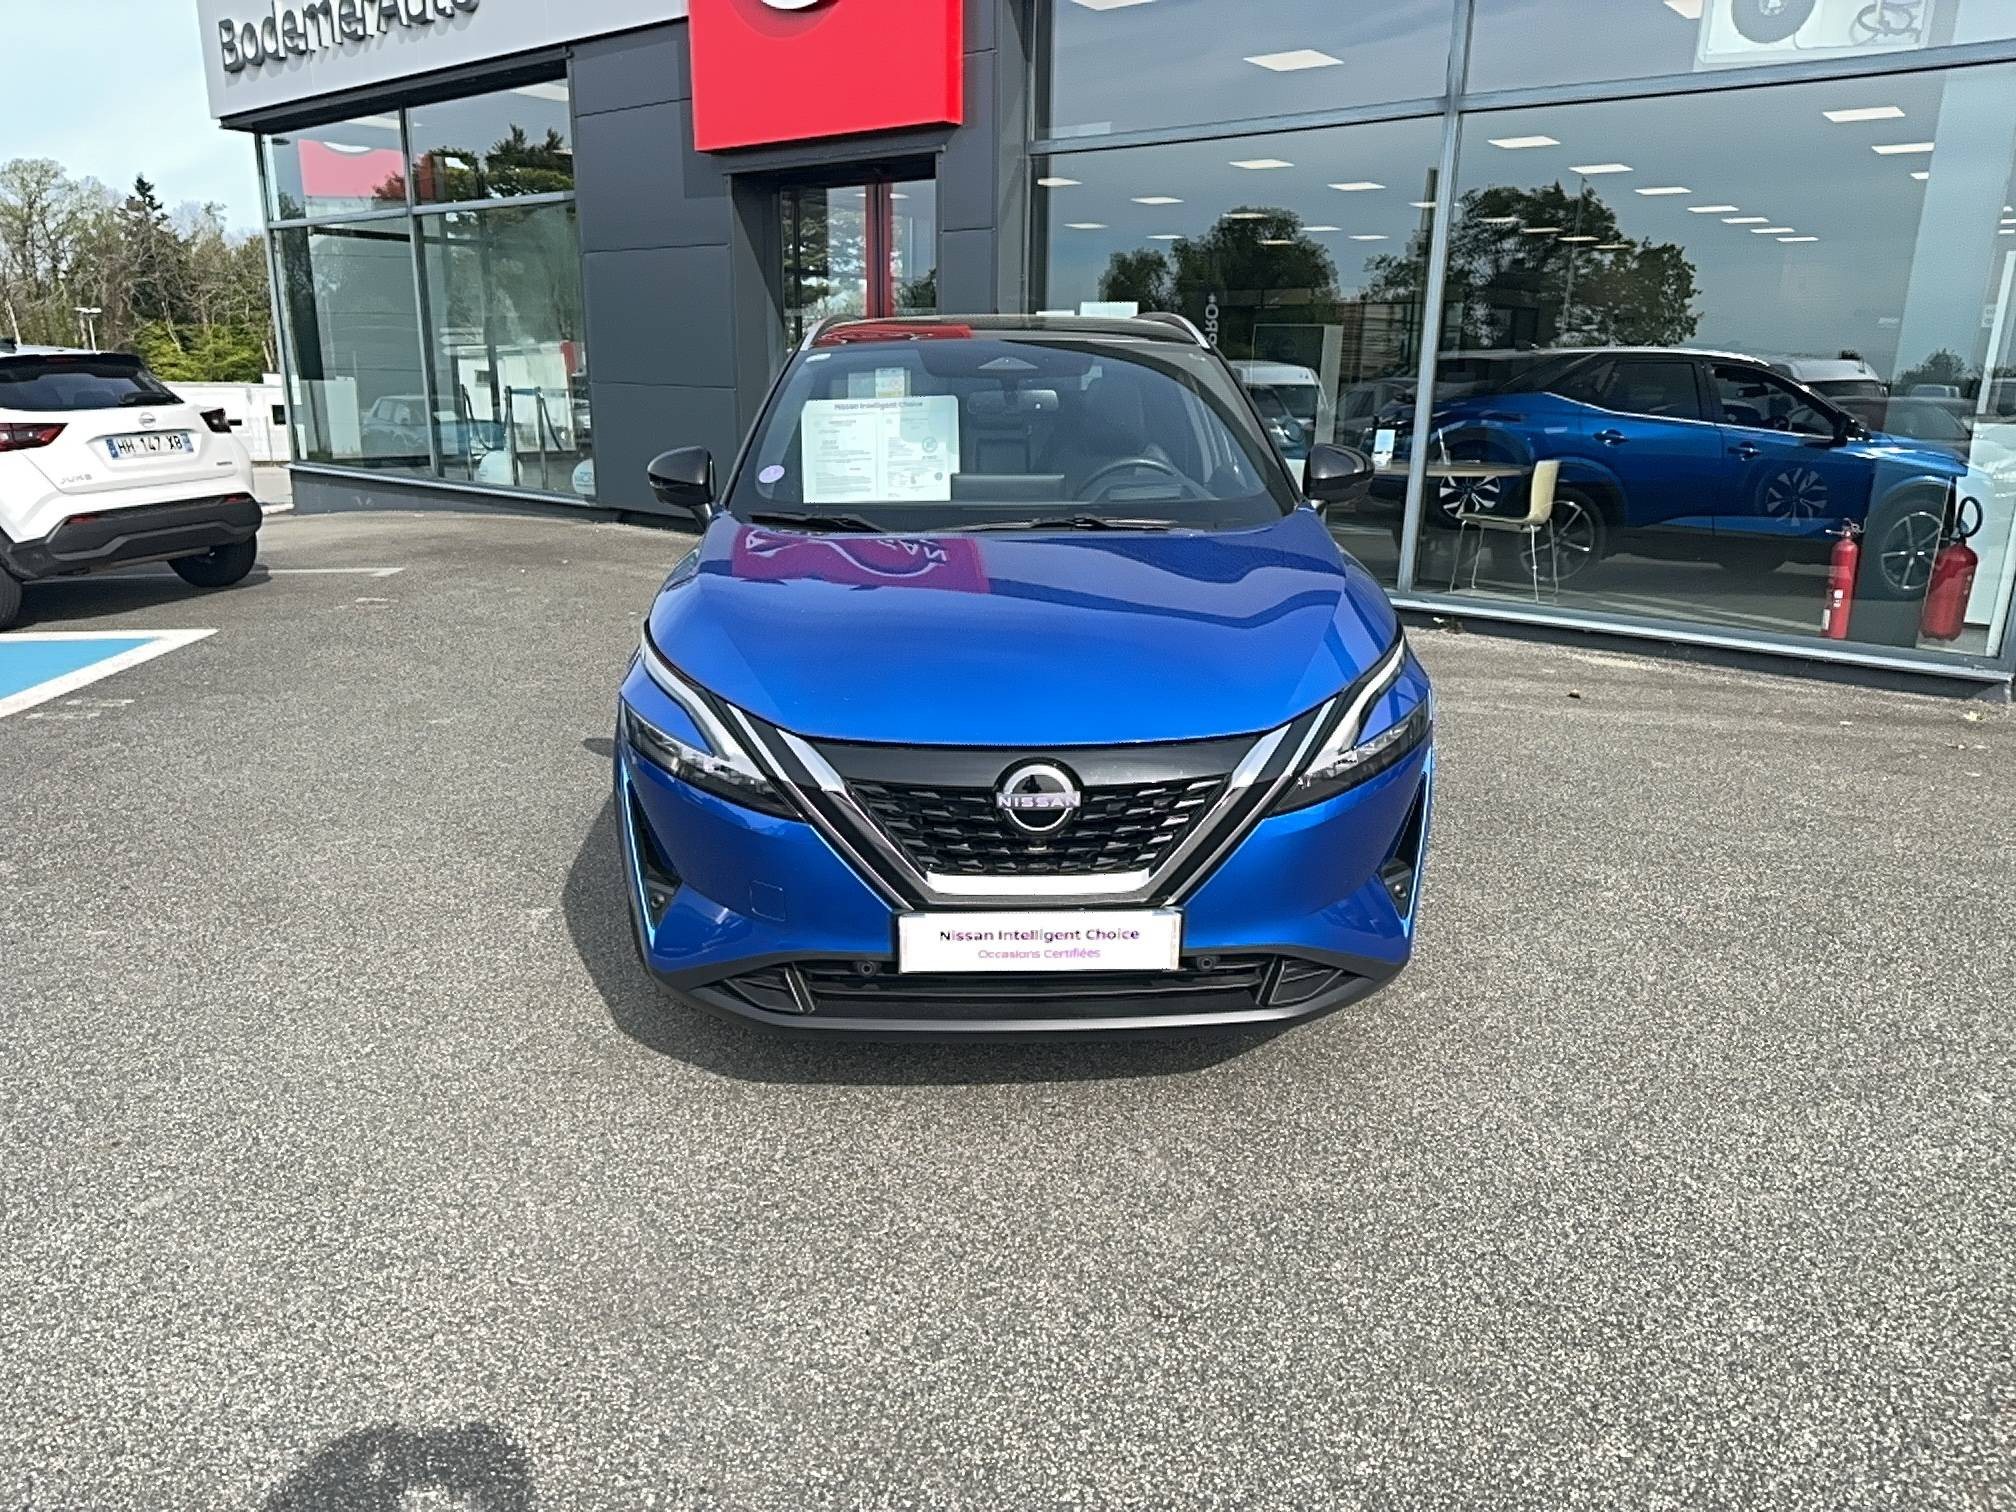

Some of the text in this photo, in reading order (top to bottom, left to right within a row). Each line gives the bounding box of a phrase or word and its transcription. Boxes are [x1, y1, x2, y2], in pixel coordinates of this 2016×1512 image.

[998, 792, 1081, 808] NISSAN
[939, 928, 1141, 944] Nissan Intelligent Choice
[977, 948, 1101, 959] Occasions Certifiées
